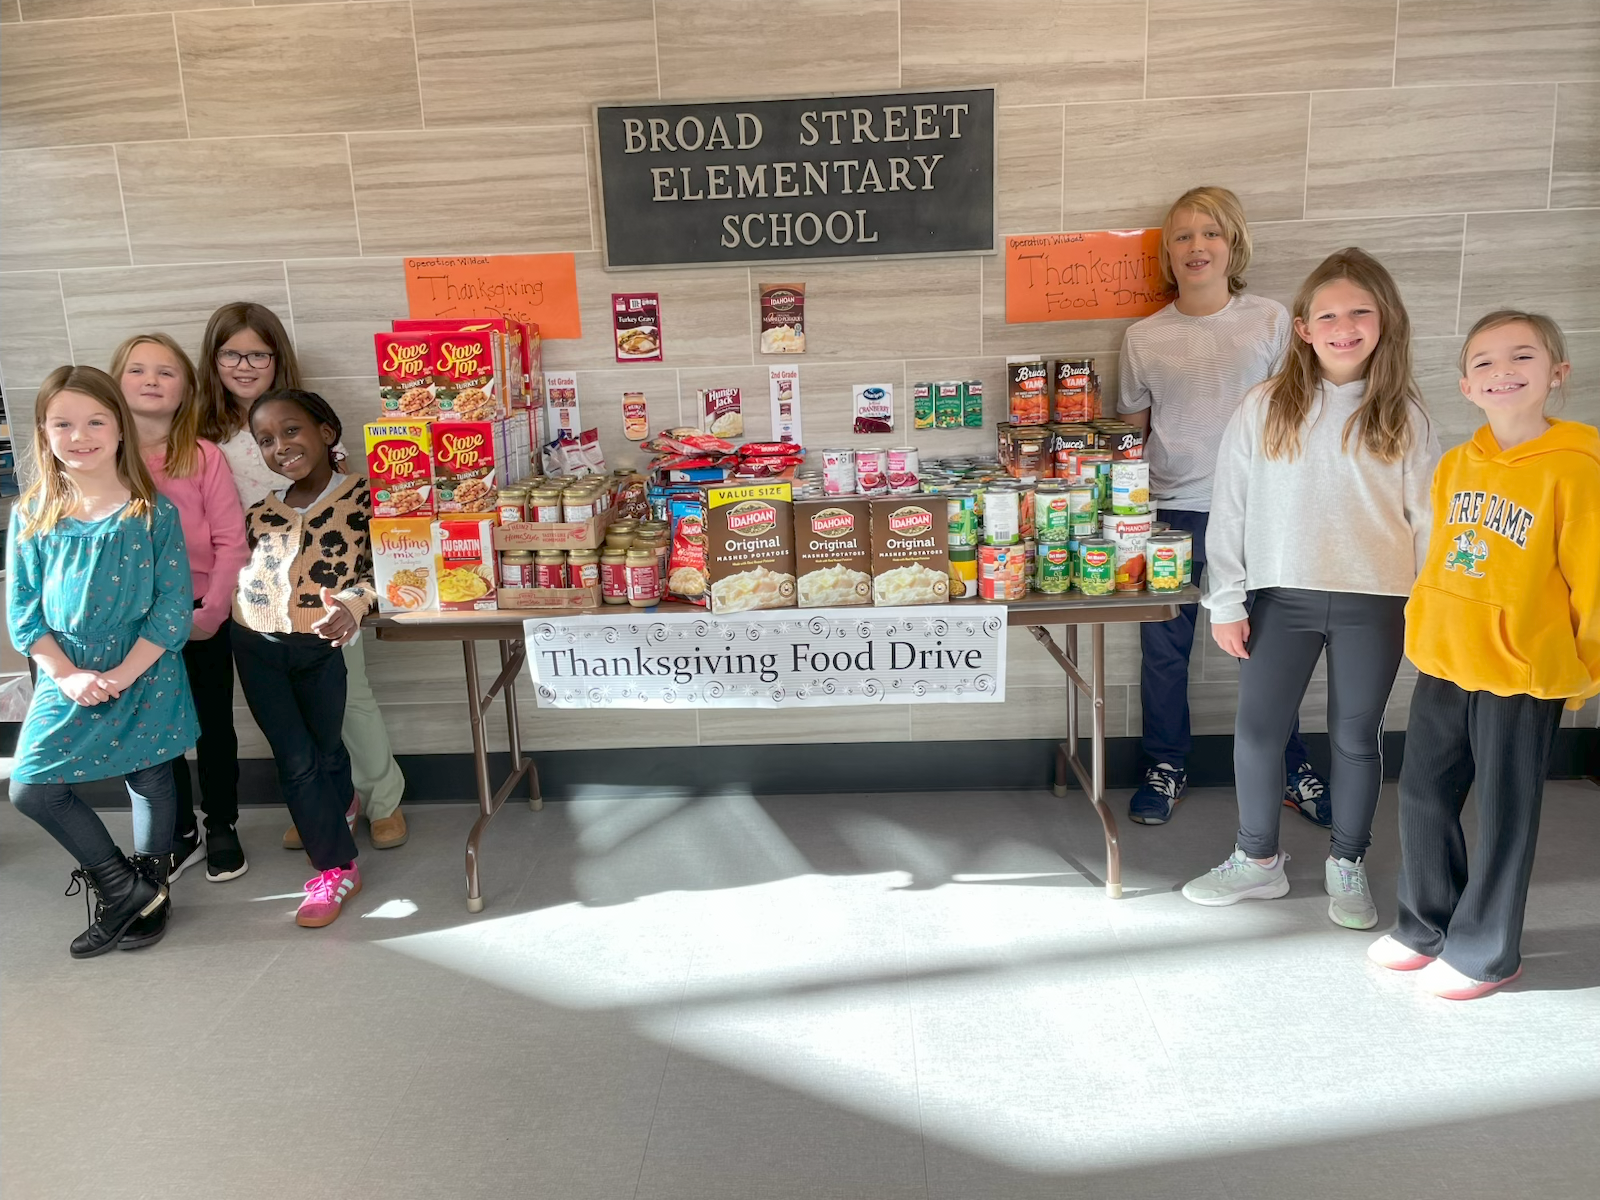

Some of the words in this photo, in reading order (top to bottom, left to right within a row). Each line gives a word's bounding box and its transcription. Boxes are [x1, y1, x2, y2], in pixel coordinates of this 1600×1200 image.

[623, 112, 763, 153] BROAD
[800, 104, 969, 146] STREET
[650, 154, 944, 201] ELEMENTARY
[720, 209, 879, 248] SCHOOL
[1010, 238, 1050, 249] Operation
[1051, 234, 1084, 245] Wildcat
[408, 258, 456, 269] Operation
[457, 257, 490, 265] Wildcat
[1018, 250, 1160, 291] Thanksgivin
[417, 274, 544, 308] Thanksgiving
[1105, 289, 1168, 306] Drive
[770, 296, 795, 305] IDAHOAN
[1046, 289, 1098, 313] Food
[618, 316, 637, 324] Turkey
[383, 342, 429, 372] Stove
[437, 342, 483, 372] Stove
[400, 358, 424, 378] Top
[454, 358, 478, 378] Top
[771, 371, 780, 379] 2nd
[781, 370, 797, 378] Grade
[1015, 367, 1046, 382] Bruce's
[1058, 364, 1090, 379] Bruce's
[400, 378, 425, 390] TURKEY
[456, 378, 479, 390] TURKEY
[1024, 380, 1044, 389] YAMS
[1066, 378, 1087, 387] YAMS
[709, 388, 738, 402] Hungry
[714, 396, 733, 410] Jack
[859, 405, 889, 414] CRANBERRY
[369, 427, 387, 437] TWIN
[389, 426, 407, 436] PACK
[438, 433, 484, 463] Stove
[1055, 436, 1084, 451] Bruce's
[1118, 434, 1142, 450] Bruc
[373, 444, 419, 474] Stove
[455, 449, 479, 469] Top
[1059, 452, 1068, 460] YA
[1128, 448, 1142, 458] YAM
[391, 461, 414, 480] Top
[456, 470, 480, 480] TURKEY
[391, 481, 415, 491] TURKEY
[719, 489, 755, 500] VALUE
[758, 487, 782, 496] SIZE
[730, 509, 774, 528] IDAHOAN
[813, 517, 852, 532] IDAHOAN
[891, 516, 930, 530] IDAHOAN
[1448, 491, 1485, 524] TRE
[1483, 495, 1533, 548] DAME
[1125, 522, 1150, 532] HANOVER
[376, 531, 430, 556] Stuffing
[443, 540, 452, 551] AU
[454, 539, 480, 551] GRATIN
[725, 536, 780, 553] Original
[809, 538, 858, 552] Original
[886, 537, 935, 551] Original
[393, 550, 414, 559] mix
[717, 554, 748, 562] MASHED
[751, 550, 790, 559] POTATOES
[542, 642, 778, 684] Thanksgiving
[791, 641, 875, 674] Food
[888, 640, 983, 671] Drive
